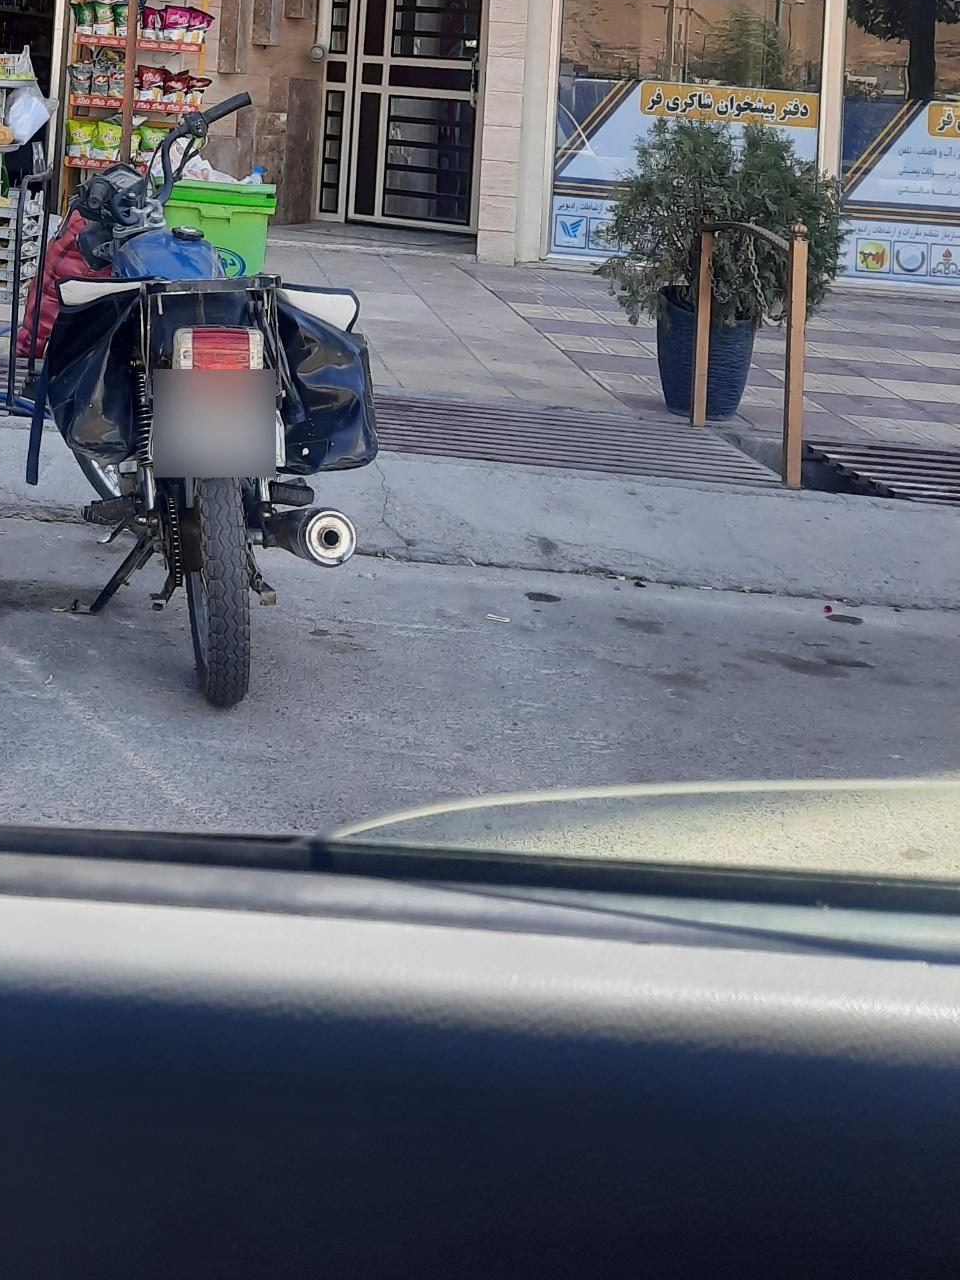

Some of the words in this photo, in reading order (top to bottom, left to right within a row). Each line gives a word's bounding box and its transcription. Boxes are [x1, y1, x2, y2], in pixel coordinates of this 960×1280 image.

[646, 88, 663, 111] فر
[666, 92, 714, 112] شاکری
[717, 96, 775, 120] پیشخوان
[778, 98, 810, 120] دفتر
[936, 108, 954, 132] فر
